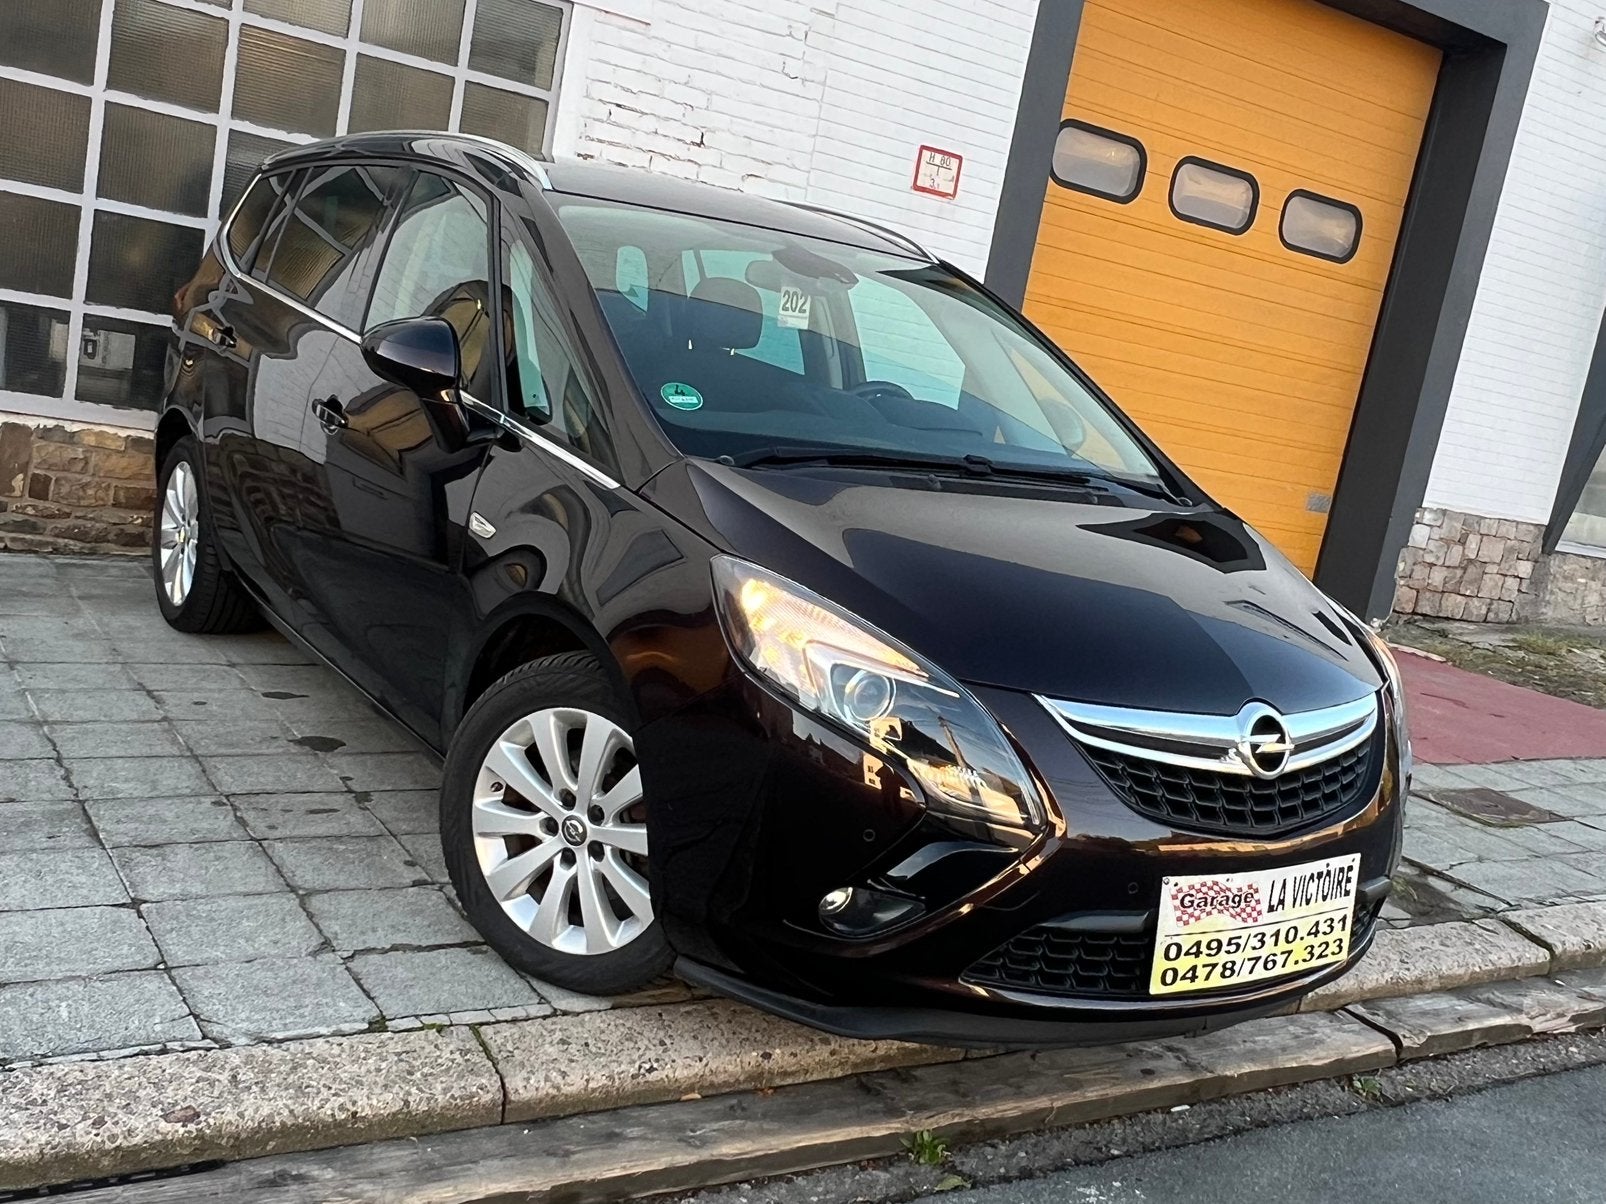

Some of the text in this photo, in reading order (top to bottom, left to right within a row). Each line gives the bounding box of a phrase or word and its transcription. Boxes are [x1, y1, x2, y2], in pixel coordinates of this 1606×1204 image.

[1179, 864, 1354, 914] Garage LA VICTOIRE
[1160, 938, 1344, 987] 0478/767.323
[1163, 914, 1348, 962] 0495/310.431
